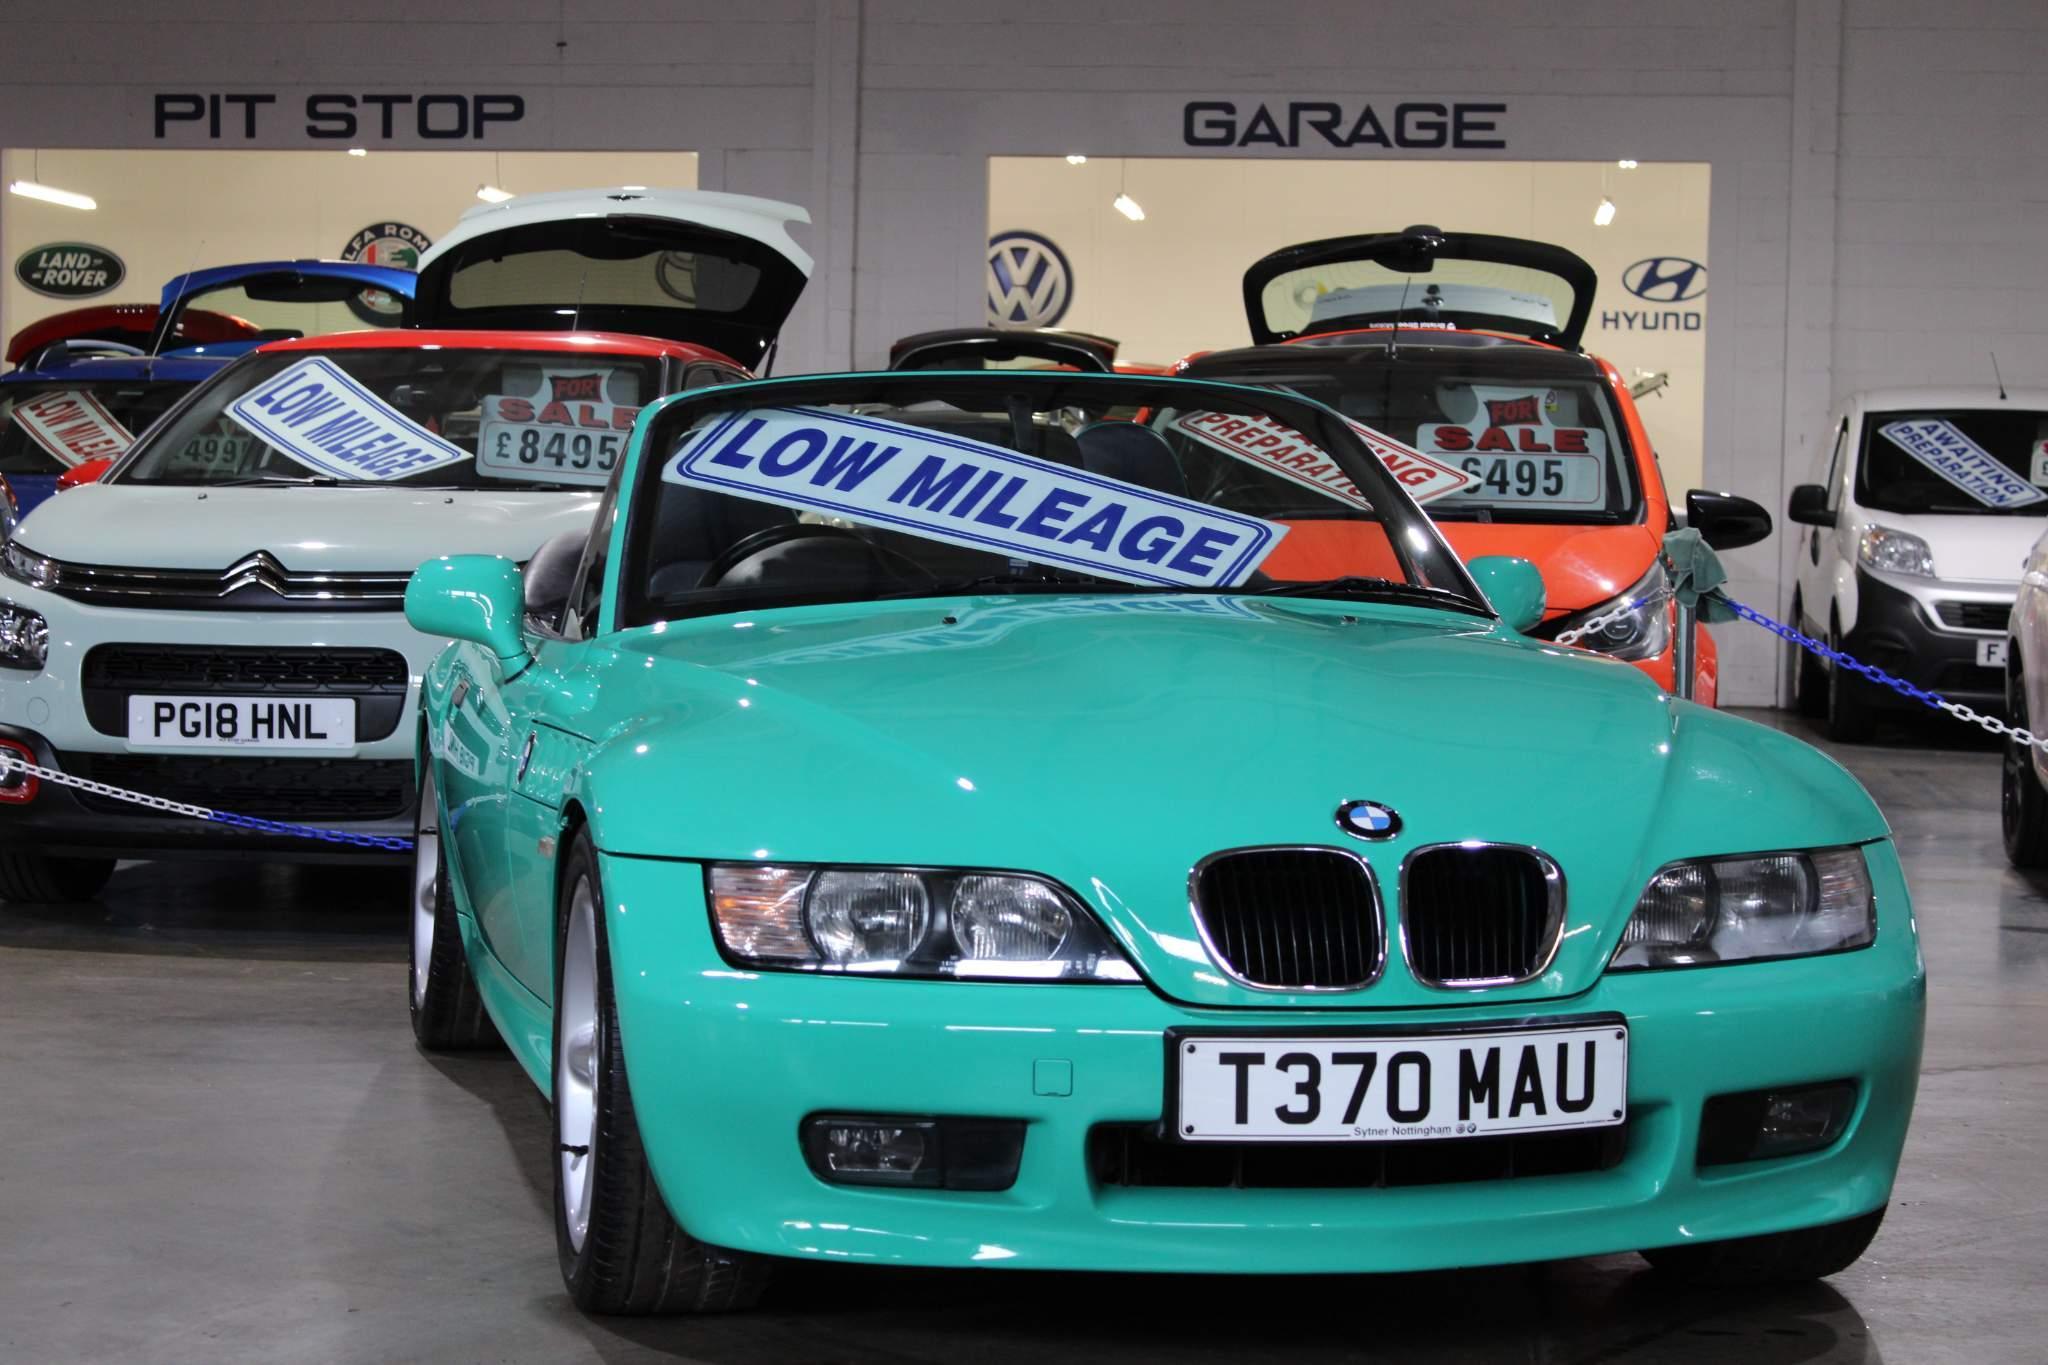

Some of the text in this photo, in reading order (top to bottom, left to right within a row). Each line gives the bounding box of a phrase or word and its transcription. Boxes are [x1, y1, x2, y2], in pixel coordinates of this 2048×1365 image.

[154, 94, 525, 139] PIT STOP
[1183, 101, 1507, 149] GARAGE
[344, 223, 429, 260] LFA ROM
[38, 252, 92, 269] LAND
[43, 269, 107, 286] ROVER
[1602, 311, 1701, 330] HYUND
[554, 378, 596, 398] FOR
[28, 391, 89, 428] LOW
[254, 371, 438, 477] LOW MILEAGE
[498, 398, 640, 430] SALE
[1490, 401, 1534, 421] FOR
[496, 428, 618, 471] £8495
[1434, 426, 1589, 453] SALE
[1893, 425, 2012, 503] PREPARATION
[1919, 423, 2025, 495] AWAITING
[710, 417, 1239, 577] LOW MILEAGE
[1987, 643, 2006, 662] F
[154, 702, 327, 739] PG18 HNL
[1218, 1040, 1597, 1125] T370 MAU
[1354, 1125, 1452, 1138] Sytner Nottingham
